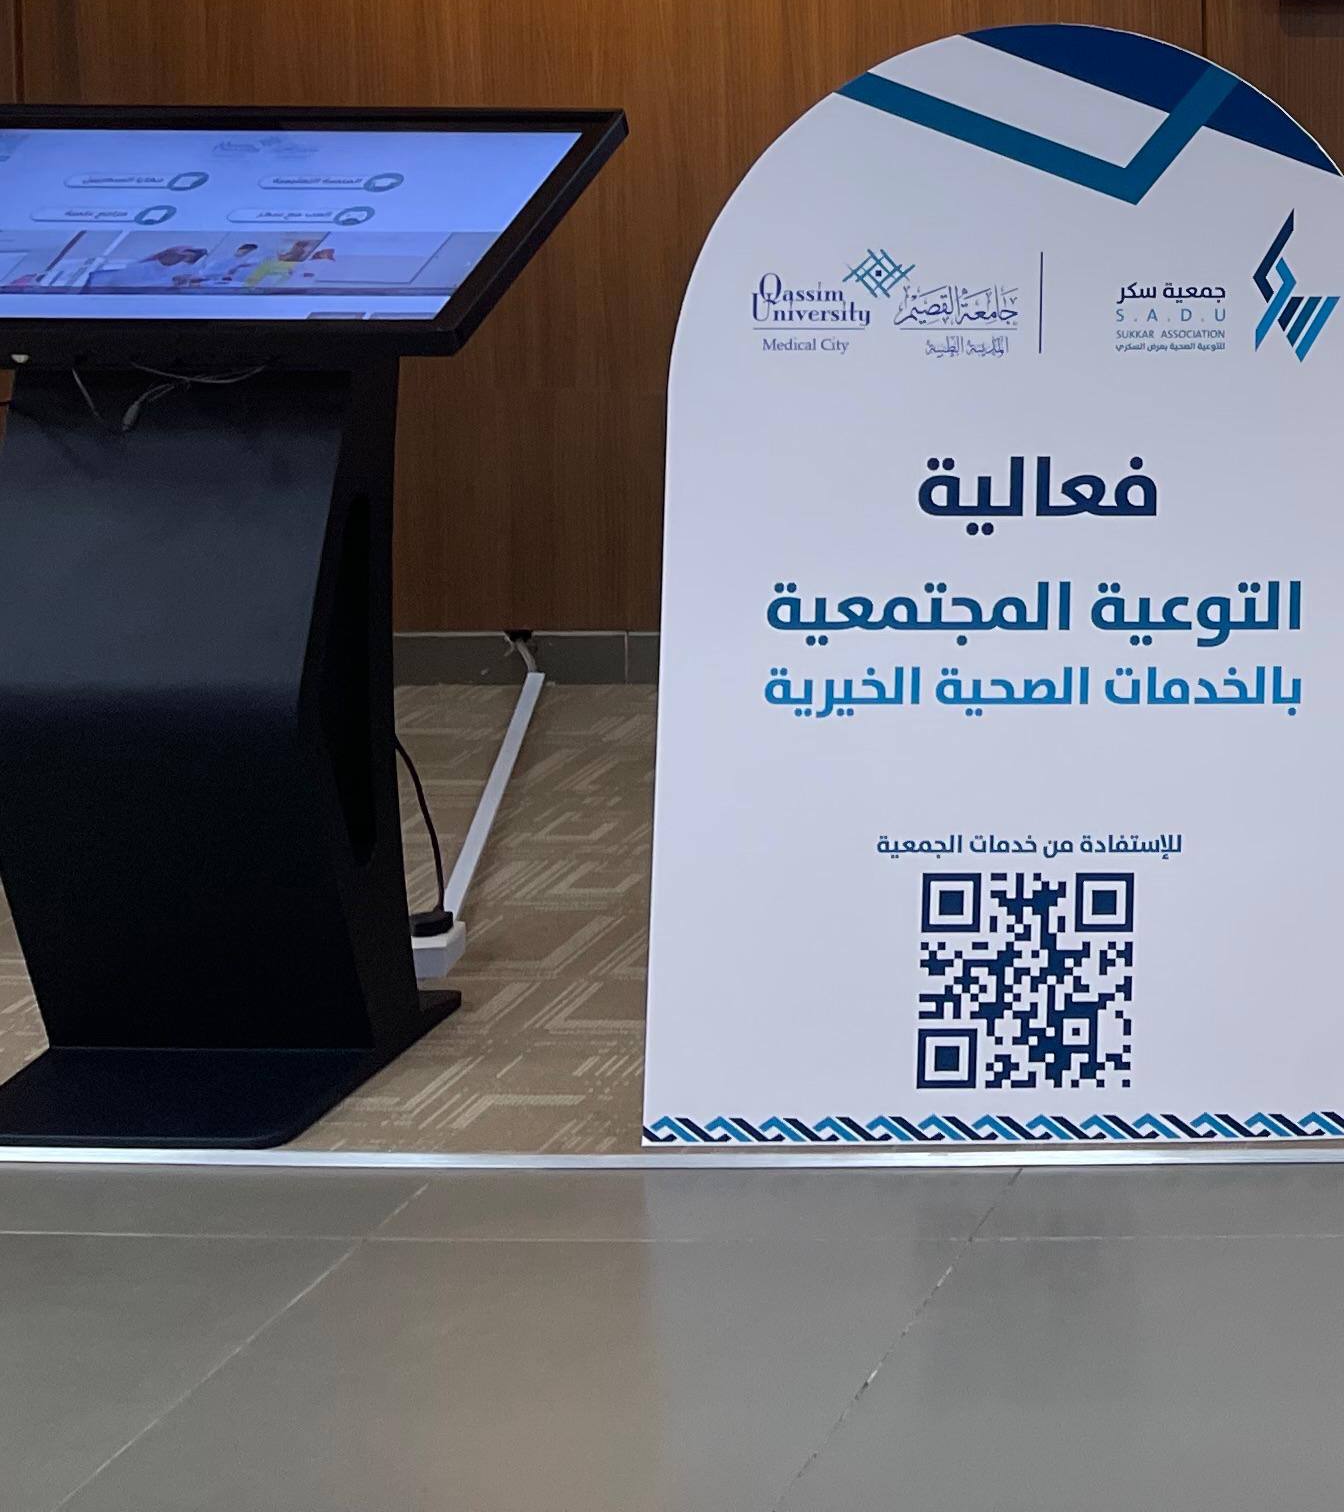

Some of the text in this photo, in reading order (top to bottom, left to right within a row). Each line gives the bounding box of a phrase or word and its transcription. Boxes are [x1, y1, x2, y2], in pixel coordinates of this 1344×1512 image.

[760, 273, 845, 306] Qassim
[1117, 282, 1225, 304] جمعية سكر
[753, 291, 871, 327] University
[763, 338, 849, 354] Medical City
[1117, 330, 1225, 338] SUKKAR ASSOCIATION
[919, 456, 1157, 535] فعالية
[767, 581, 1301, 647] التوعية المجتمعية
[765, 666, 1301, 718] بالخدمات الصحية الخيرية
[877, 835, 1181, 859] للإستفادة من خدمات الجمعية
